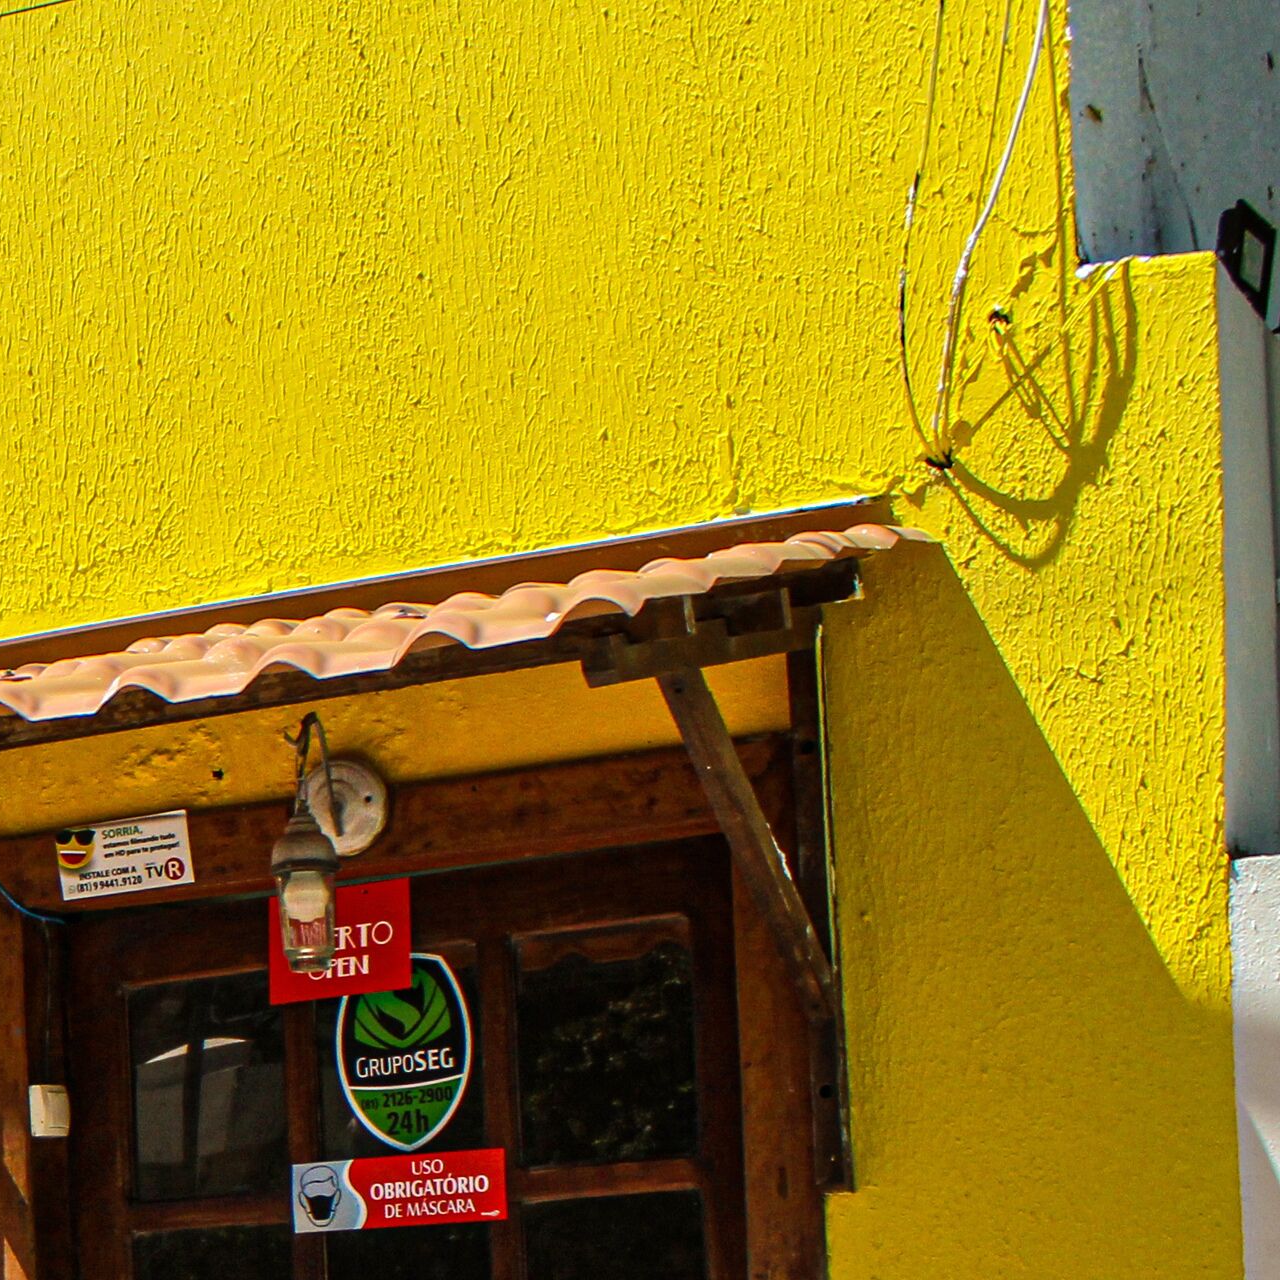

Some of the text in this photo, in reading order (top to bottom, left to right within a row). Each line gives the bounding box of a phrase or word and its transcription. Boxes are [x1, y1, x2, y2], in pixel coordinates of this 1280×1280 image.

[79, 869, 110, 880] INSTALE
[111, 866, 130, 876] COM
[387, 1108, 430, 1135] 24h
[411, 1159, 444, 1175] USO
[370, 1173, 489, 1200] OBRIGATÓRIO
[384, 1198, 476, 1219] DE MÁSCARA
